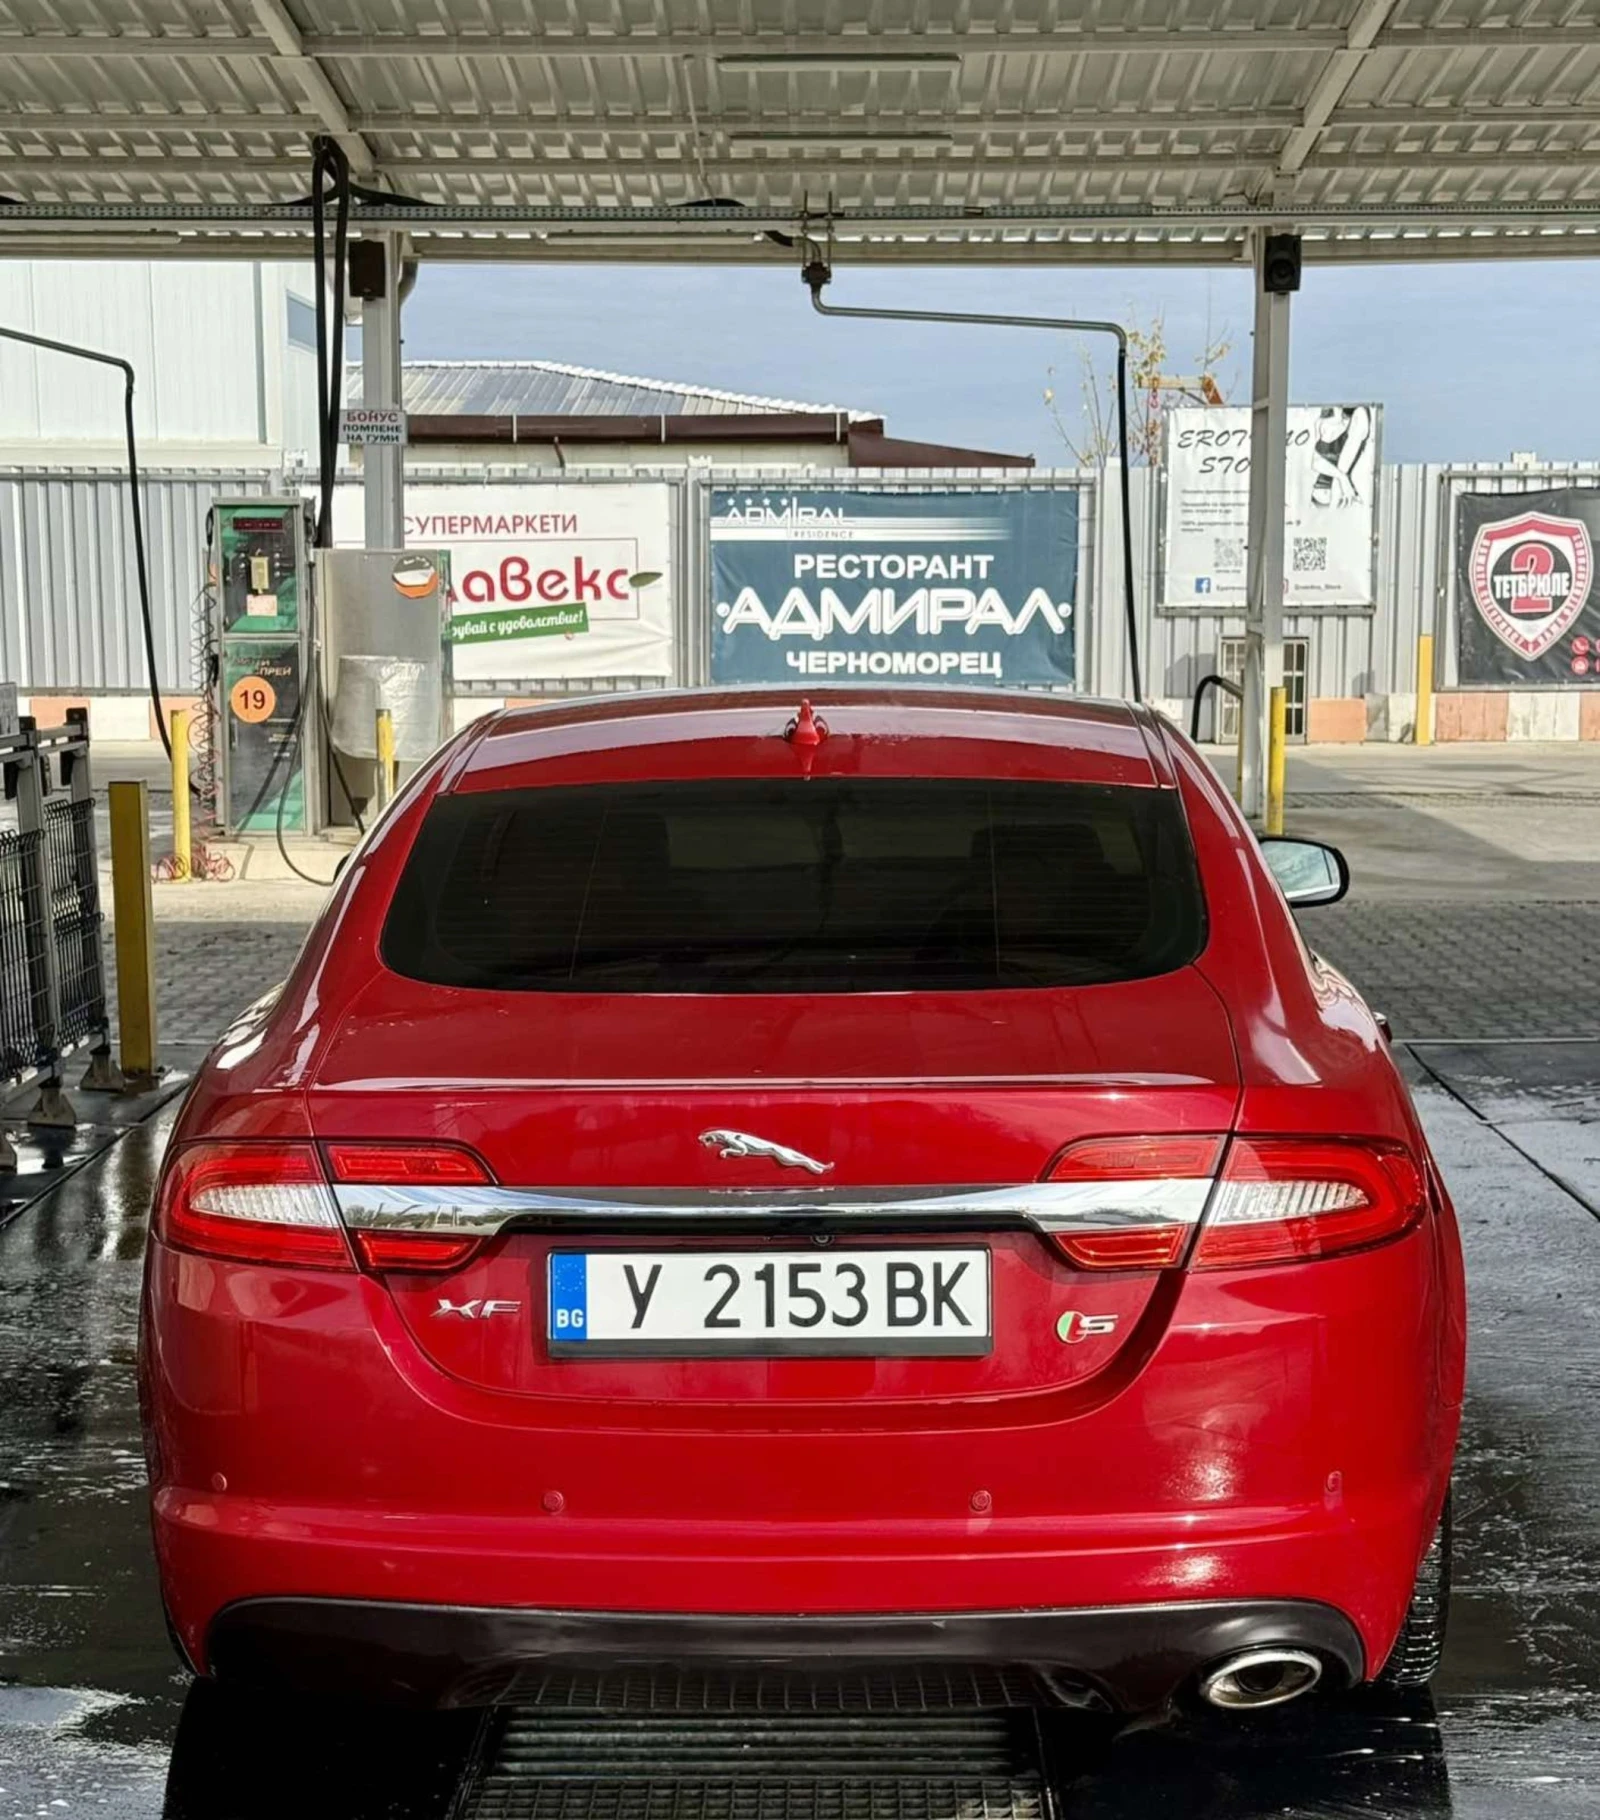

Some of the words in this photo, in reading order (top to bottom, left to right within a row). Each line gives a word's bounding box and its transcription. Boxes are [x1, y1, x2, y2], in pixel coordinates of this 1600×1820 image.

[346, 411, 398, 422] БОНУС
[343, 424, 402, 433] ПОМПЕНЕ
[346, 434, 363, 442] НА
[366, 434, 399, 444] ГУМИ
[724, 497, 855, 526] ADMIRAL
[794, 530, 854, 539] RESIDENCE
[794, 554, 994, 579] РЕСТОРАНТ
[722, 587, 1066, 641] АДМИРАЛ
[786, 652, 1002, 678] ЧЕРНОМОРЕЦ
[239, 689, 266, 710] 19
[703, 1262, 869, 1328] 2153
[886, 1262, 972, 1327] BK
[429, 1299, 522, 1319] XF
[556, 1308, 584, 1328] BG
